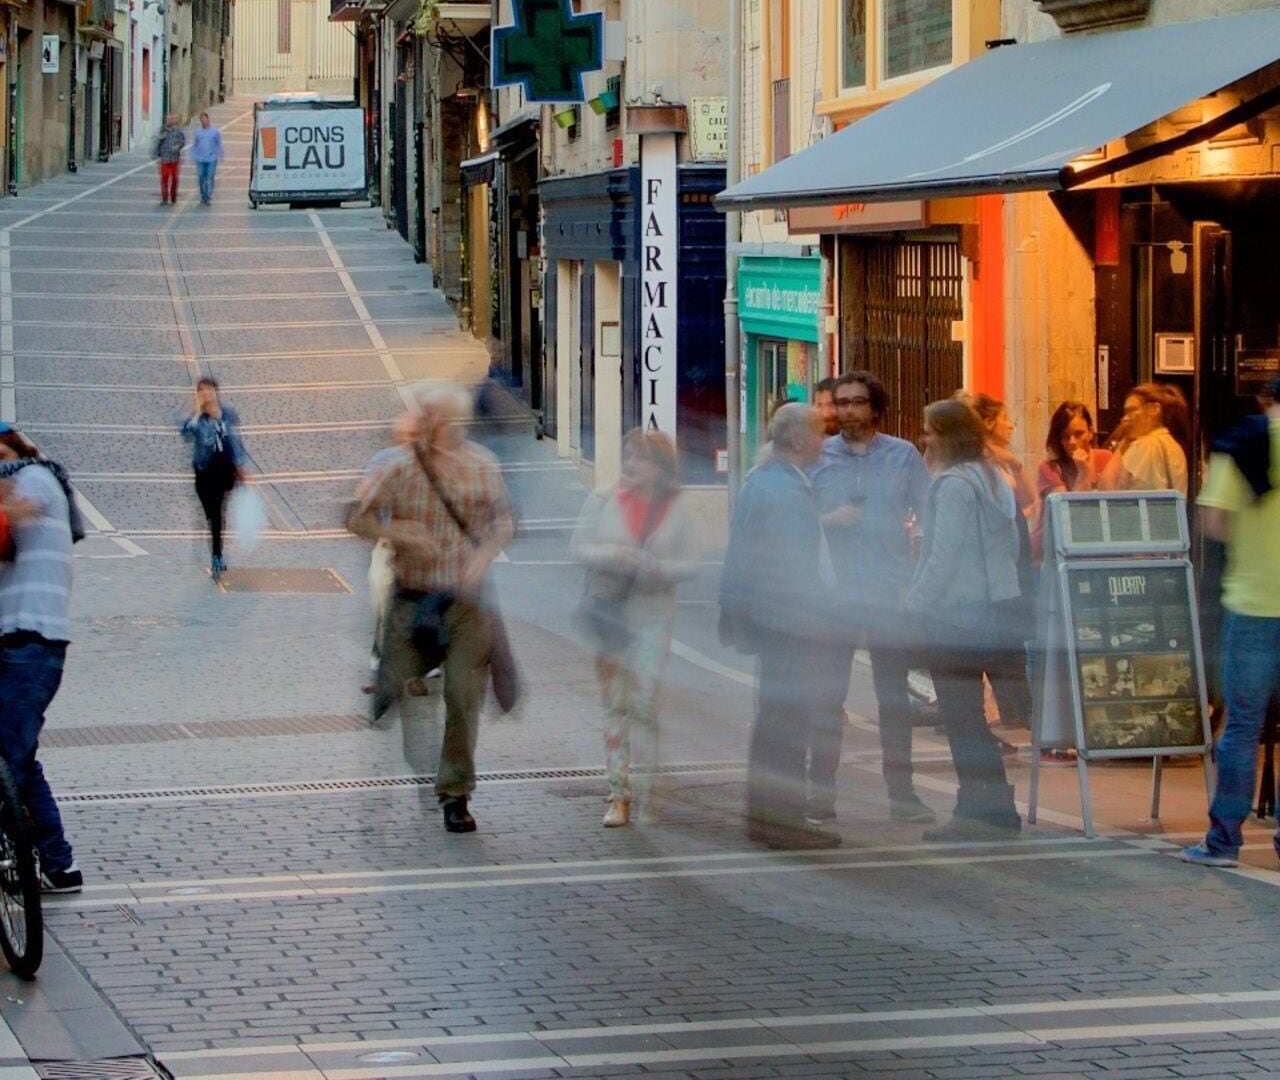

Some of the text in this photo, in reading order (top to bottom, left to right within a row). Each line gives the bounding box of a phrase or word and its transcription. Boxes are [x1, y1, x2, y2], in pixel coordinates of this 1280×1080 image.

[284, 125, 345, 144] CONS
[284, 144, 346, 170] LAU
[643, 178, 668, 434] FARMACIA
[781, 283, 819, 315] mercadere
